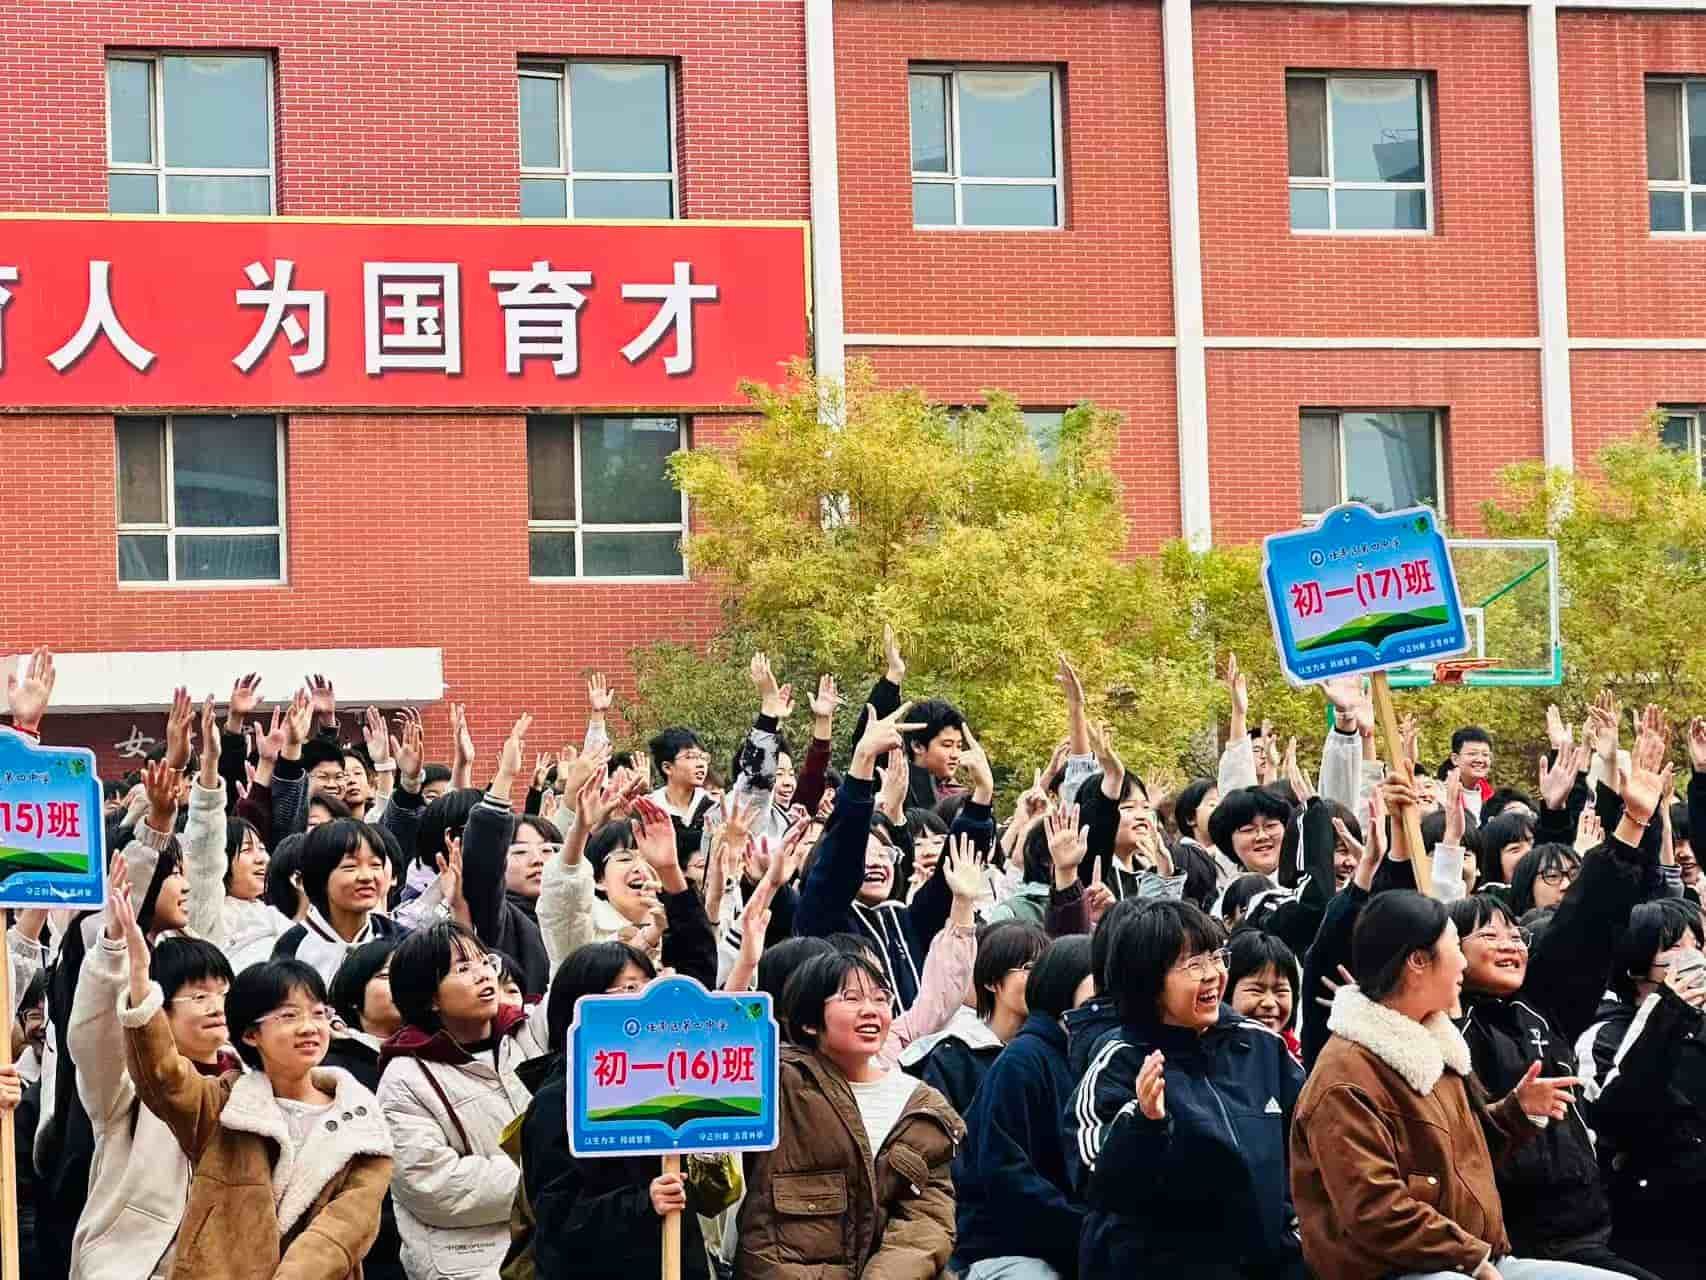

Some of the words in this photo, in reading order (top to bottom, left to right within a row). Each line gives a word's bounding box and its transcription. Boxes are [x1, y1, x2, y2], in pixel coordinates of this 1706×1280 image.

[0, 259, 157, 373] 人
[232, 258, 719, 377] 为国育才
[1290, 559, 1436, 618] 初一(17)班
[593, 1046, 755, 1087] 初一(16)班
